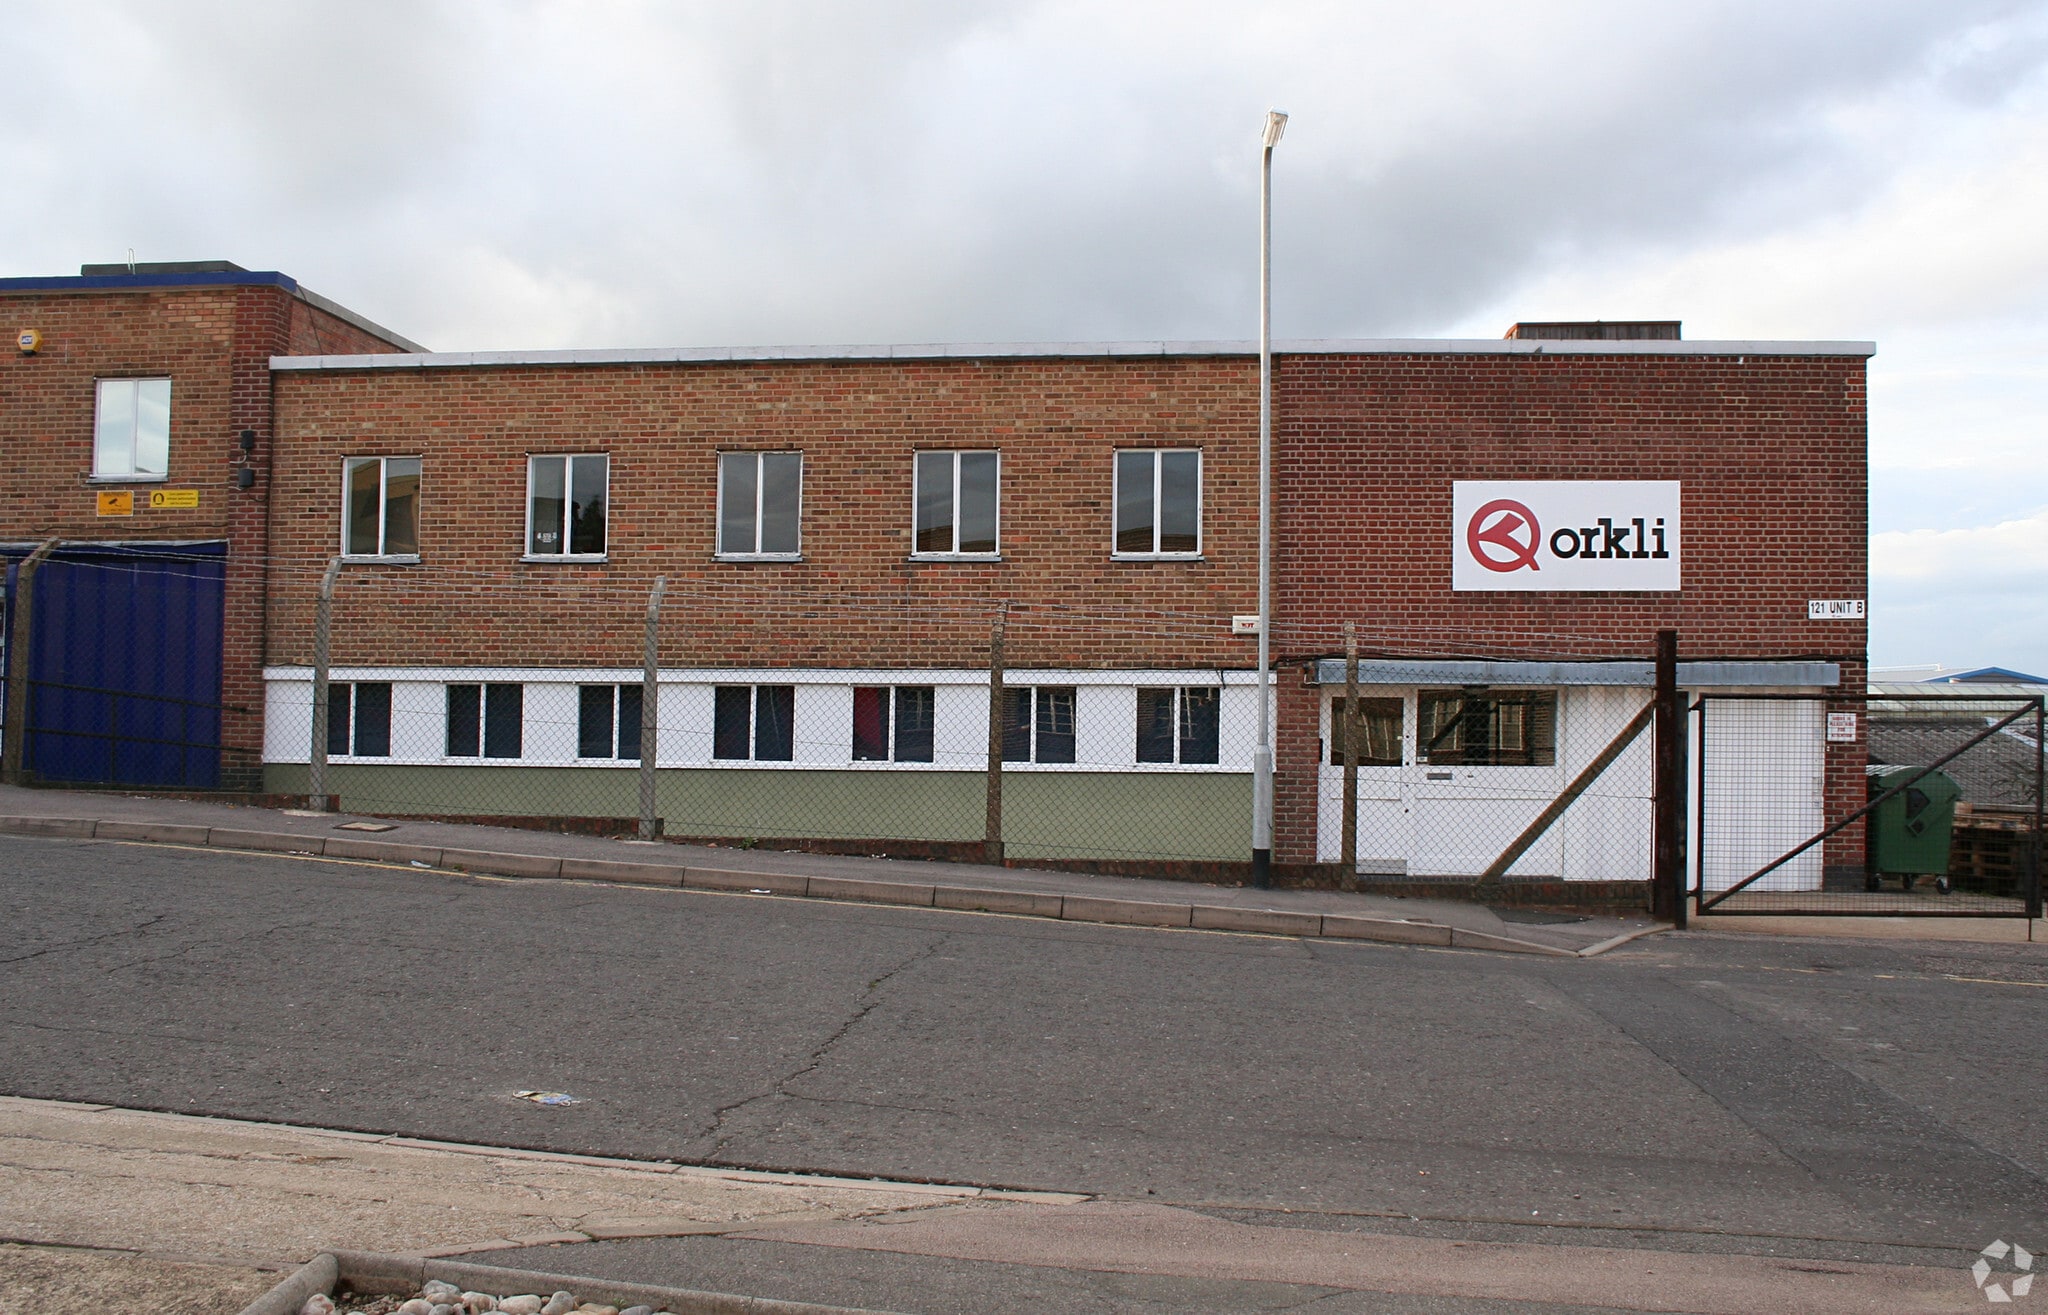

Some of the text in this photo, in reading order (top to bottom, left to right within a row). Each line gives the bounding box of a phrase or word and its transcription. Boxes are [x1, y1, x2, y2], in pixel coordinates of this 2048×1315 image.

[1549, 517, 1670, 559] orkli
[1811, 601, 1863, 613] 121 UNIT B
